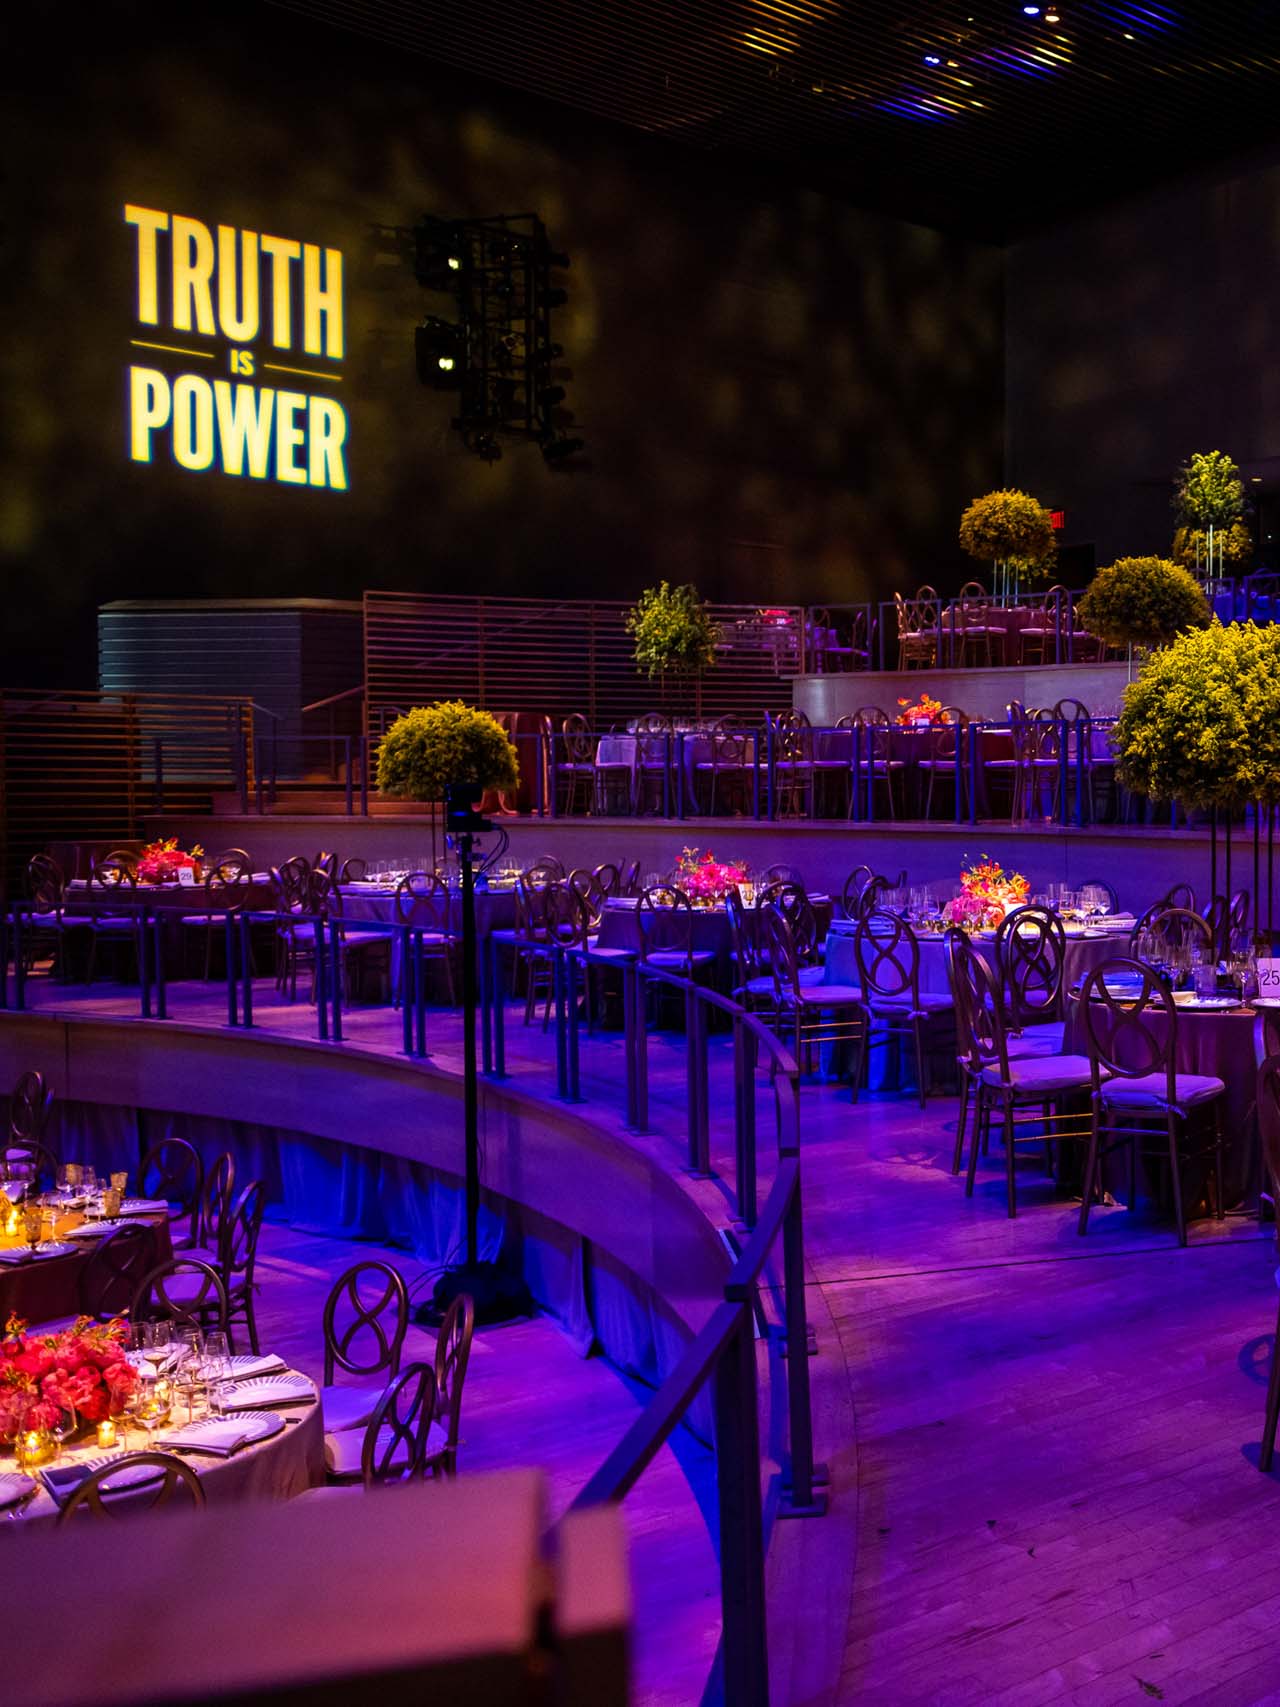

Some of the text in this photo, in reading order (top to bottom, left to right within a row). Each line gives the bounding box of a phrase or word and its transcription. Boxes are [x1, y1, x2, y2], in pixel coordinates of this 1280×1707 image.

[124, 203, 343, 360] TRUTH
[230, 348, 255, 376] IS
[130, 365, 348, 491] POWER
[1261, 969, 1280, 986] 25
